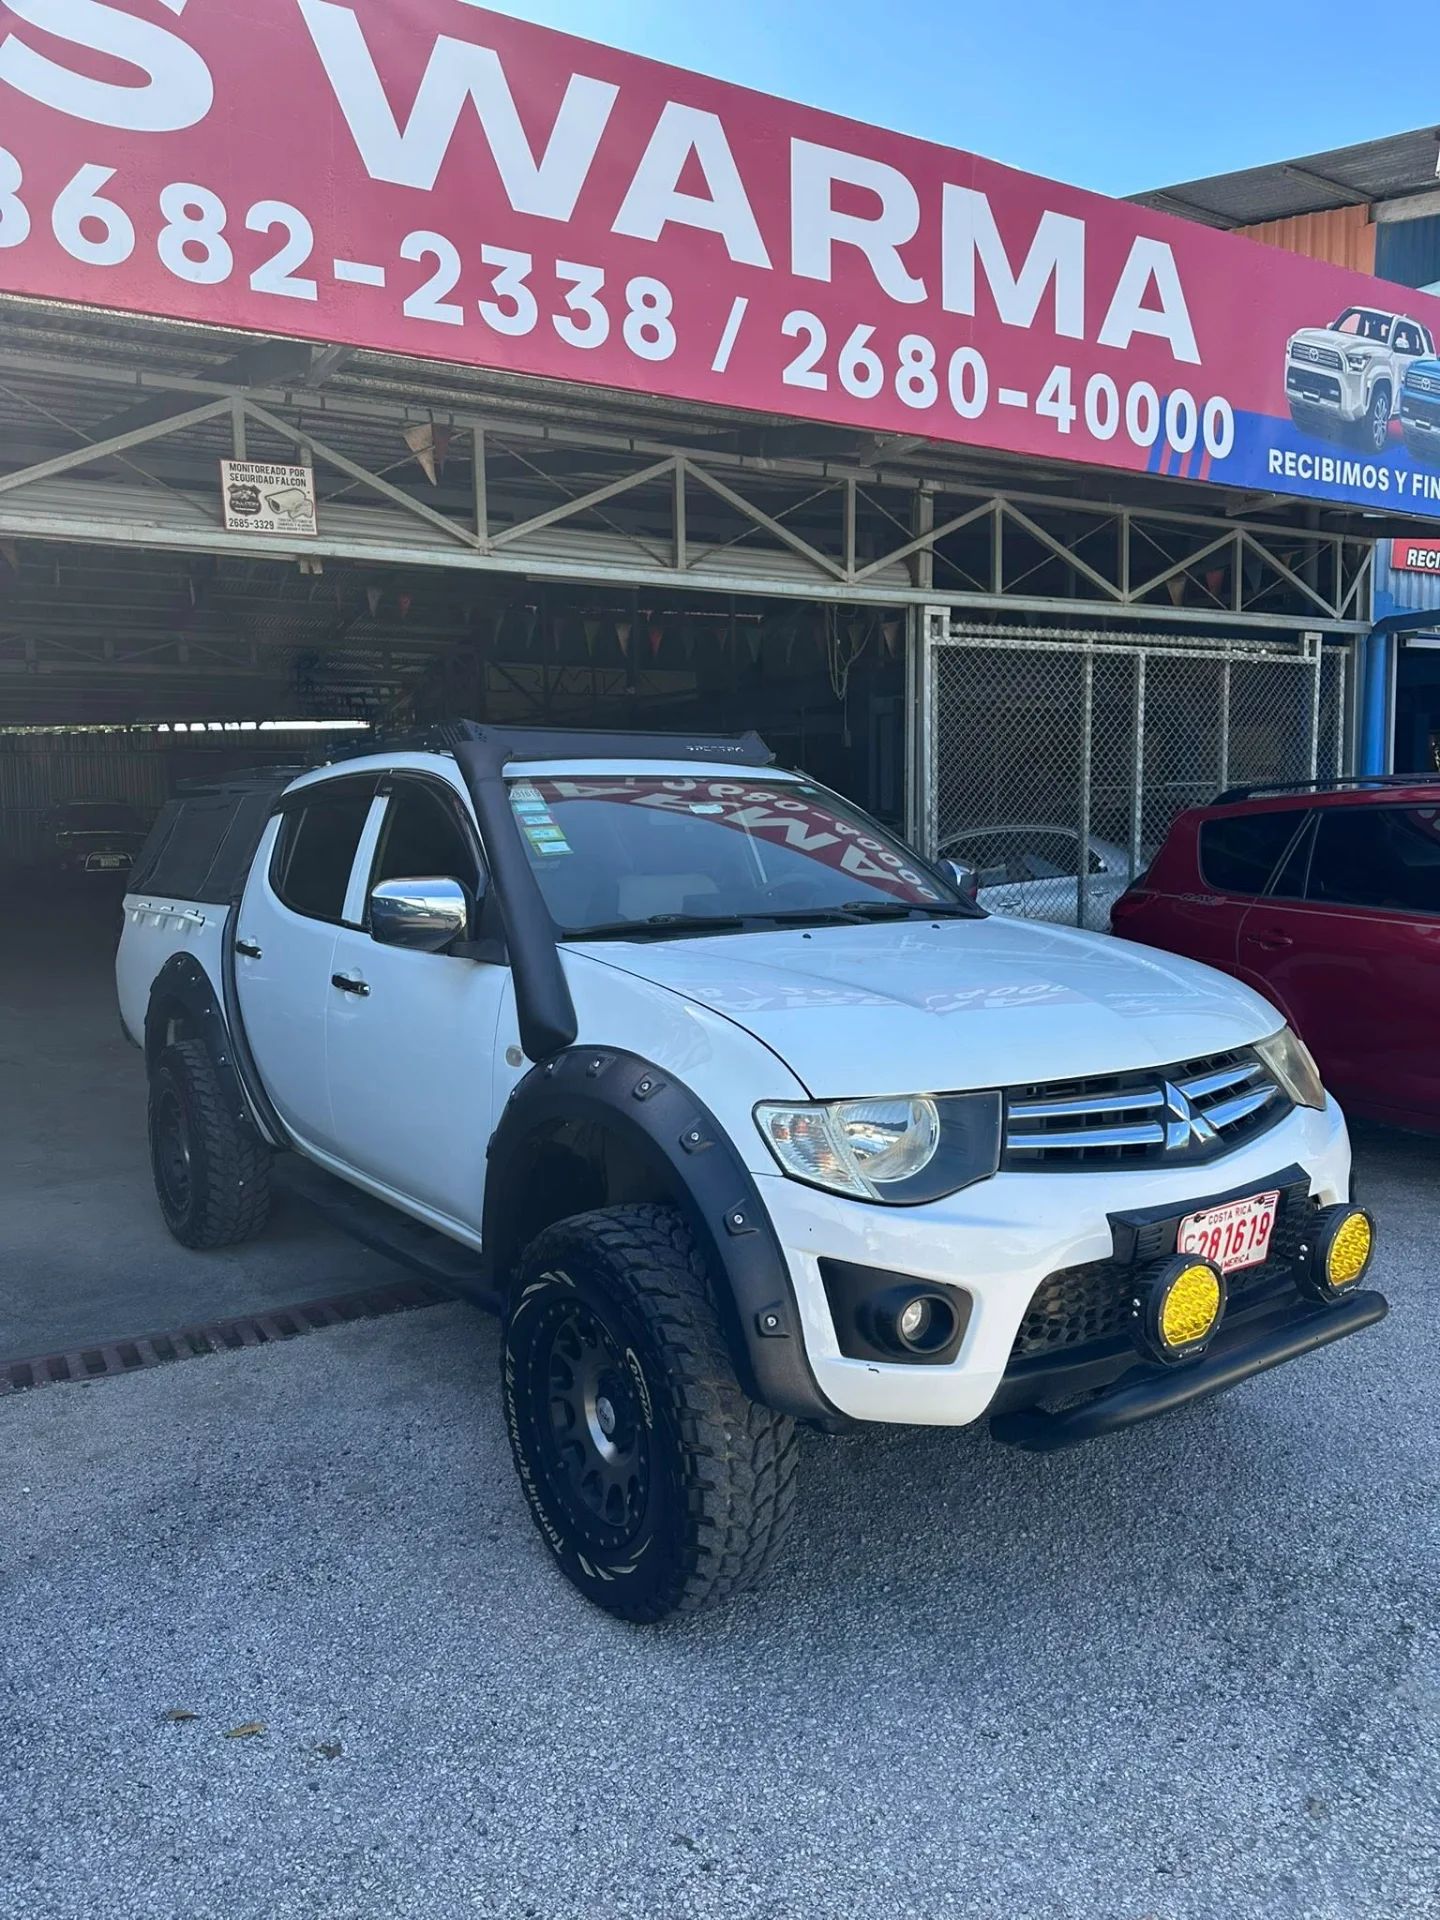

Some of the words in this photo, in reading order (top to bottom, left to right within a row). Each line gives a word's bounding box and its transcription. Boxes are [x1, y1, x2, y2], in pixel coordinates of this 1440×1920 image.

[297, 0, 1201, 365] WARMA
[712, 296, 749, 373] /
[782, 310, 1234, 459] 2680-40000
[229, 463, 286, 476] MONITOREADO
[289, 468, 305, 477] POR
[229, 473, 275, 484] SEGURIDAD
[275, 477, 306, 487] FALCON
[1269, 448, 1389, 491] RECIBIMOS
[1394, 470, 1407, 494] Y
[1412, 473, 1440, 500] FIN
[228, 518, 275, 530] 2685-3329
[1208, 1211, 1233, 1225] COSTA
[1235, 1204, 1252, 1216] RICA
